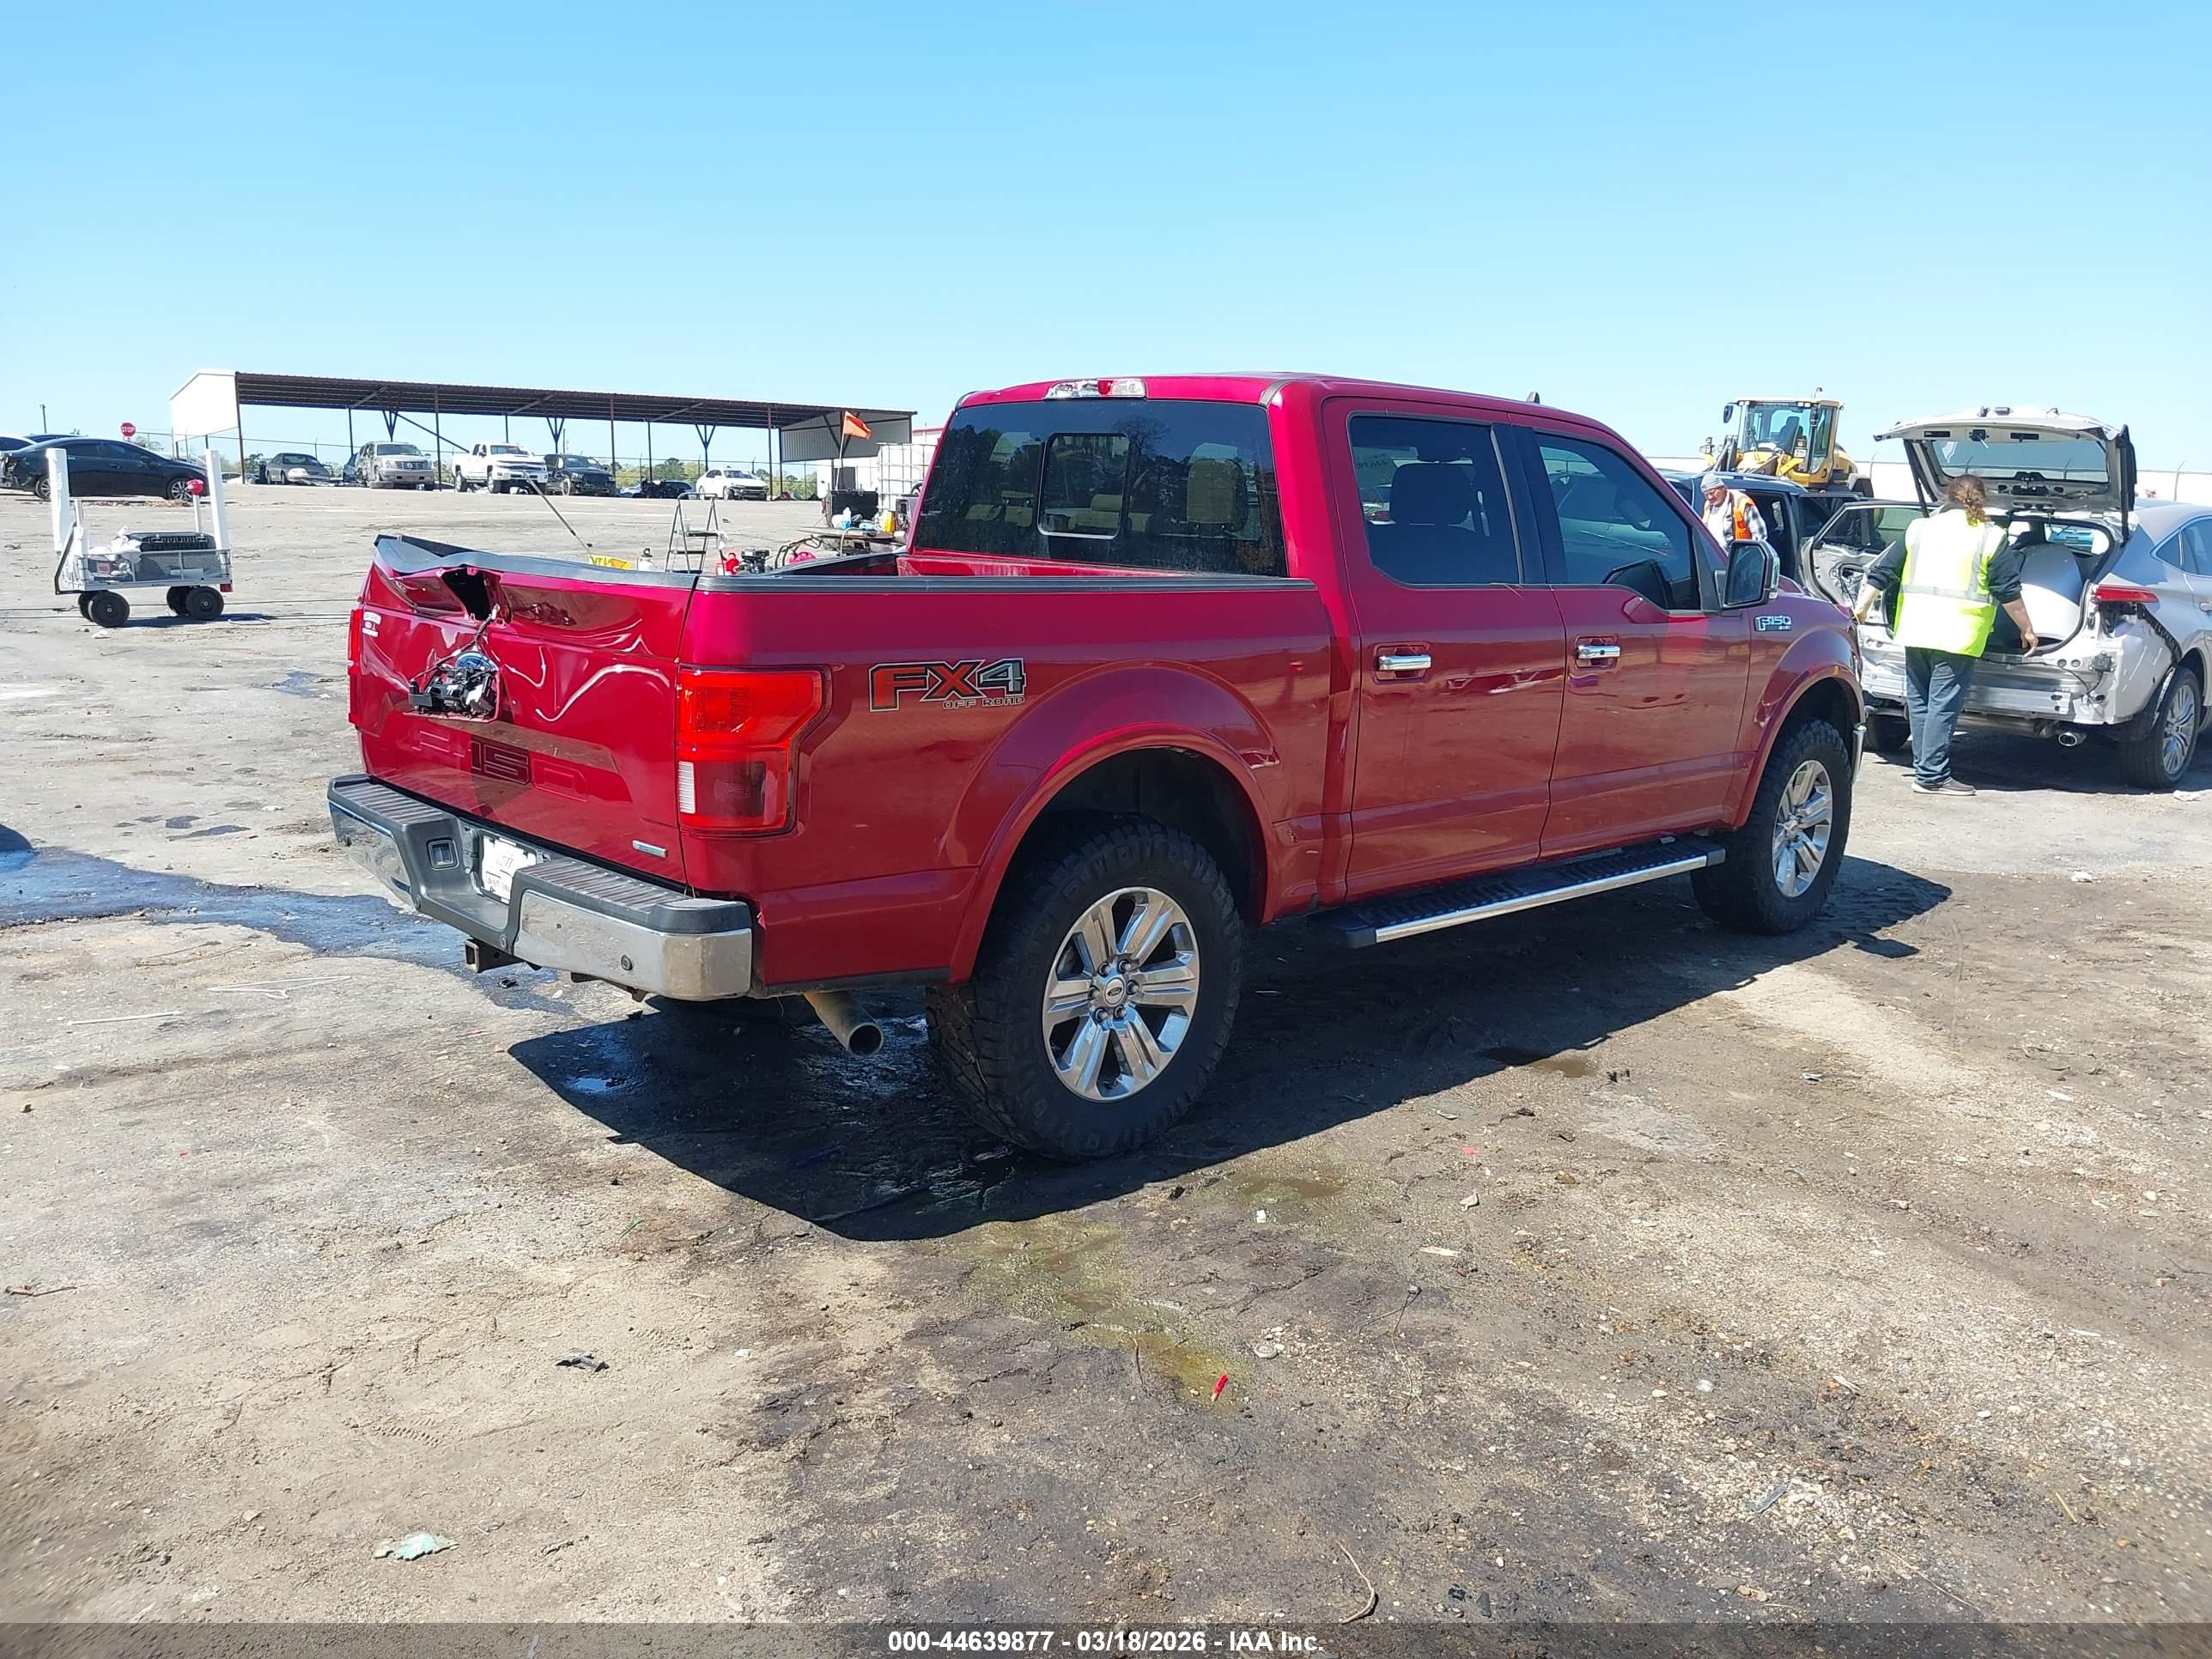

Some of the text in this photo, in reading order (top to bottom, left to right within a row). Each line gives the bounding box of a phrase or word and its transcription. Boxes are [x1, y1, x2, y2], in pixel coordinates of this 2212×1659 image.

[868, 658, 1026, 712] FX4
[943, 696, 1025, 709] OFF ROAD
